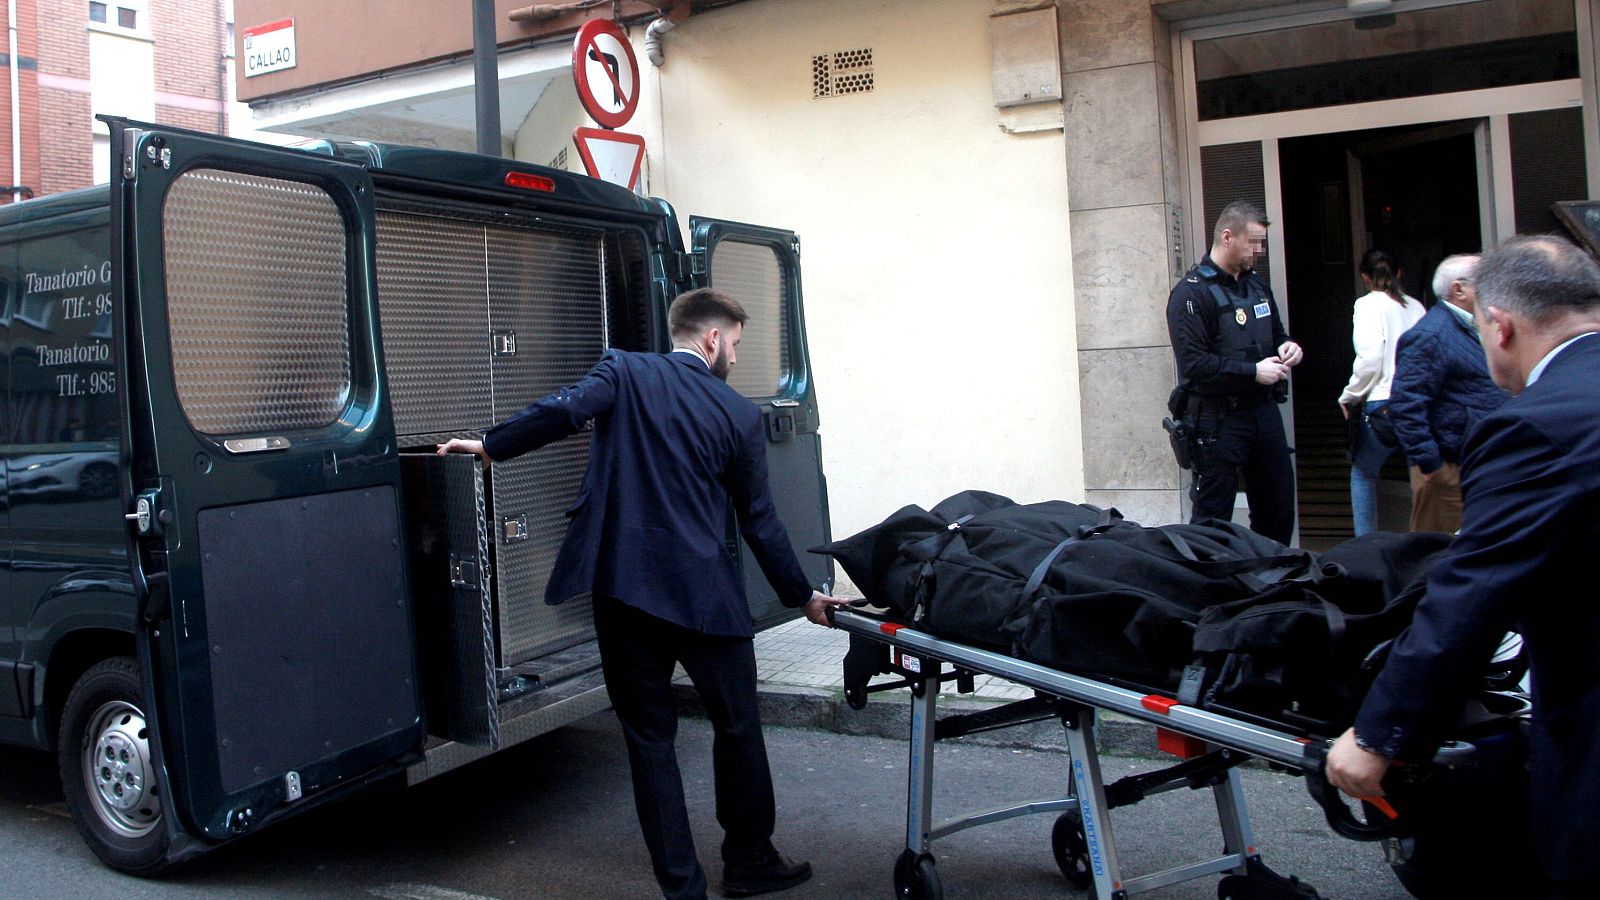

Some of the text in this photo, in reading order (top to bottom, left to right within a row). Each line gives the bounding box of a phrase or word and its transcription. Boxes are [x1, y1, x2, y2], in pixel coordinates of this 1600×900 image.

[249, 47, 290, 70] CALLAO
[25, 264, 96, 294] Tanatorio
[62, 292, 112, 320] Tlf.: 98
[36, 339, 109, 367] Tanatorio
[56, 371, 116, 397] Tlf.: 985
